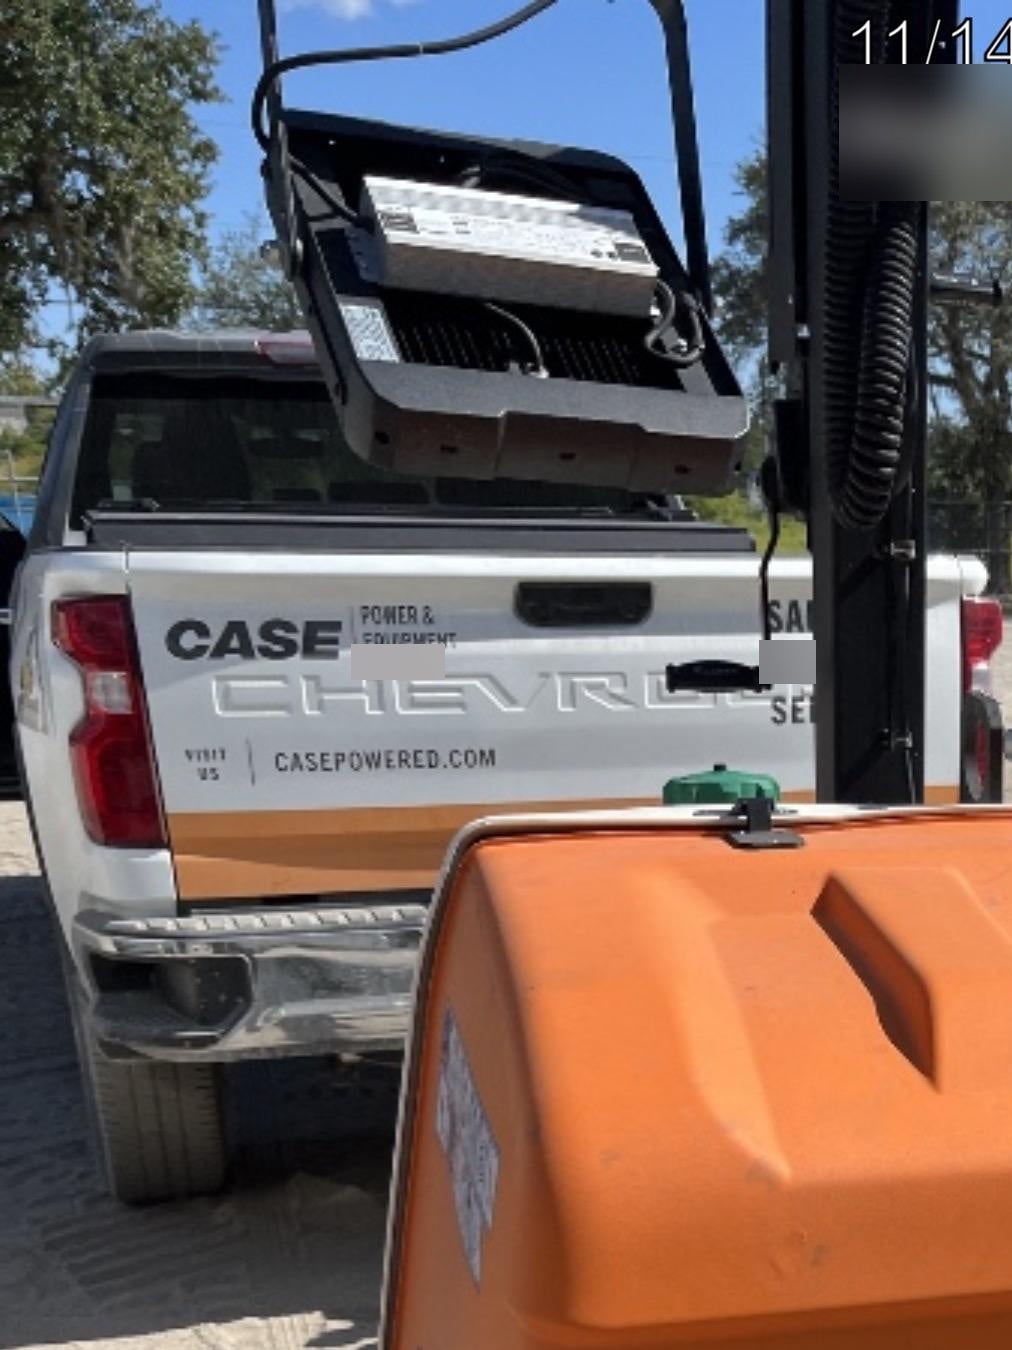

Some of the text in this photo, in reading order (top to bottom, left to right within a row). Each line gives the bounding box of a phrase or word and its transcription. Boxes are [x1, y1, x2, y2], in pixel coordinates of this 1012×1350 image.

[361, 605, 435, 625] POWER &
[165, 617, 343, 661] CASE
[274, 749, 496, 773] CASEPOWERED.COM
[198, 766, 220, 781] US
